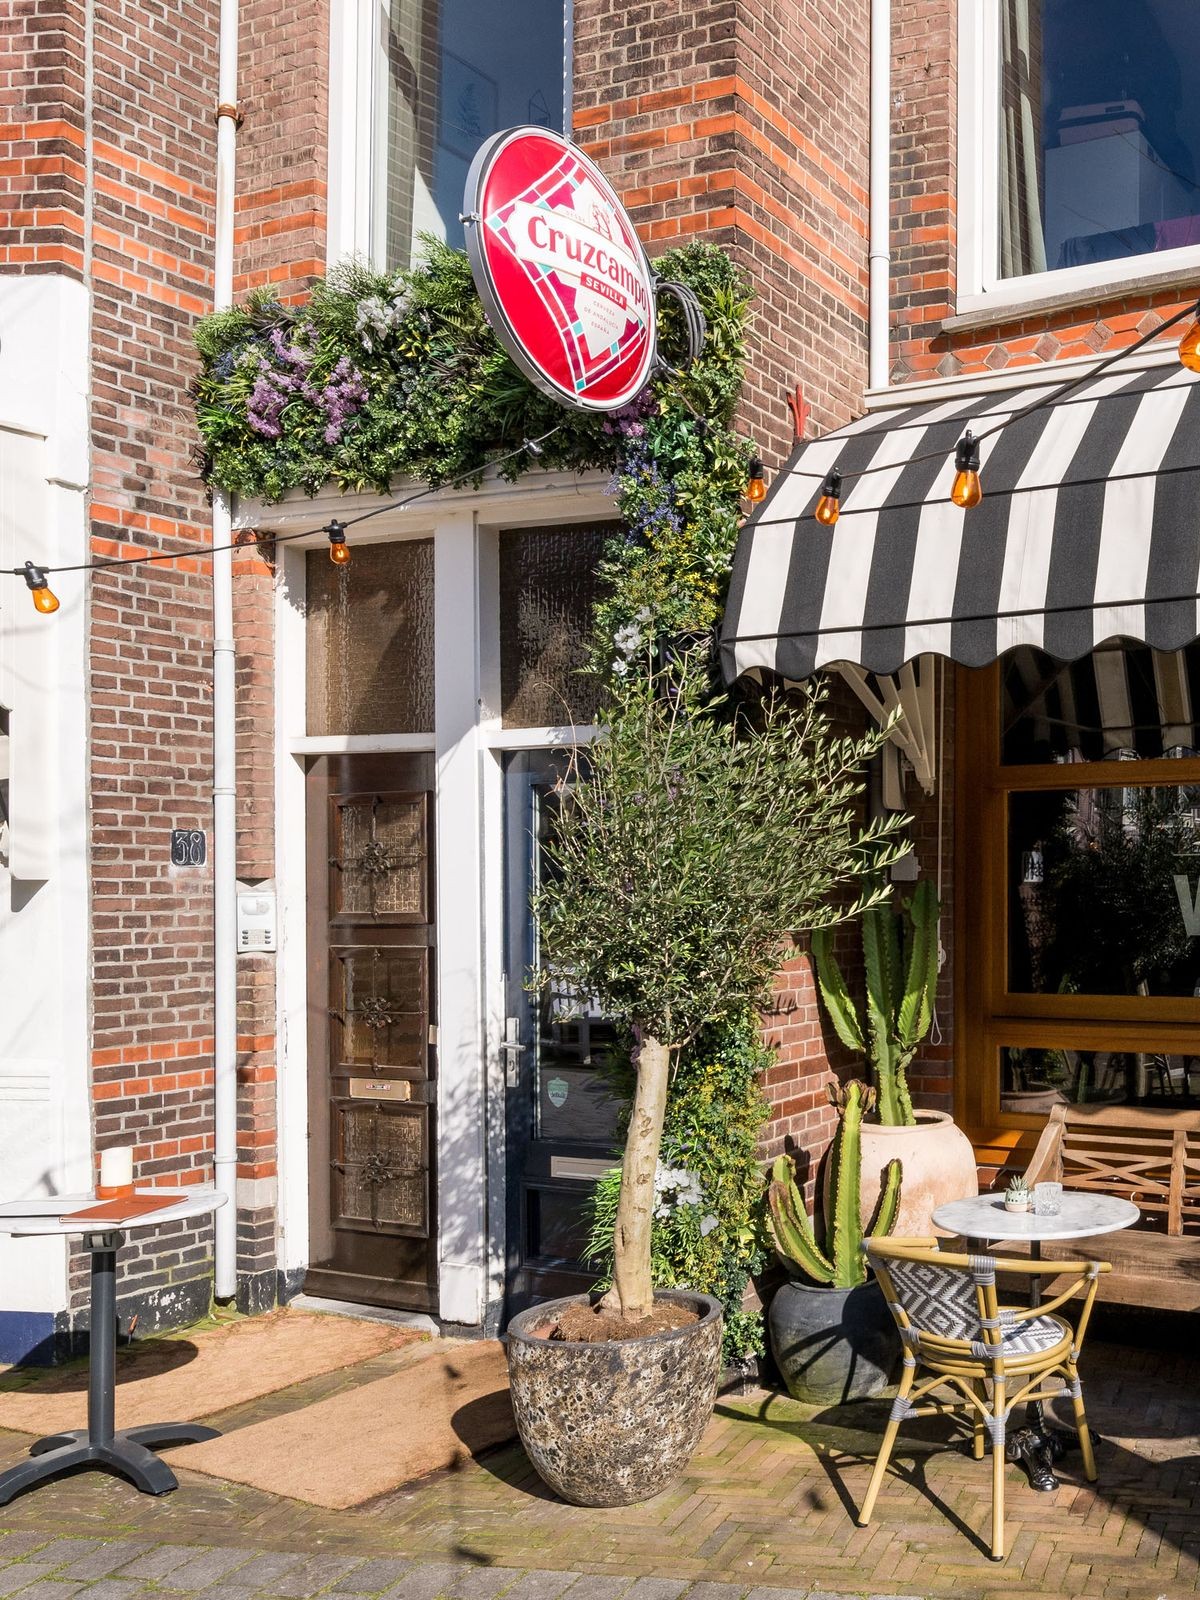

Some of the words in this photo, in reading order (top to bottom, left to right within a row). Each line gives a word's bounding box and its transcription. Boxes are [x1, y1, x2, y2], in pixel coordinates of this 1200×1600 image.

[527, 214, 647, 311] Cruzcampo
[585, 276, 625, 305] SEVILLA
[175, 831, 202, 866] 38
